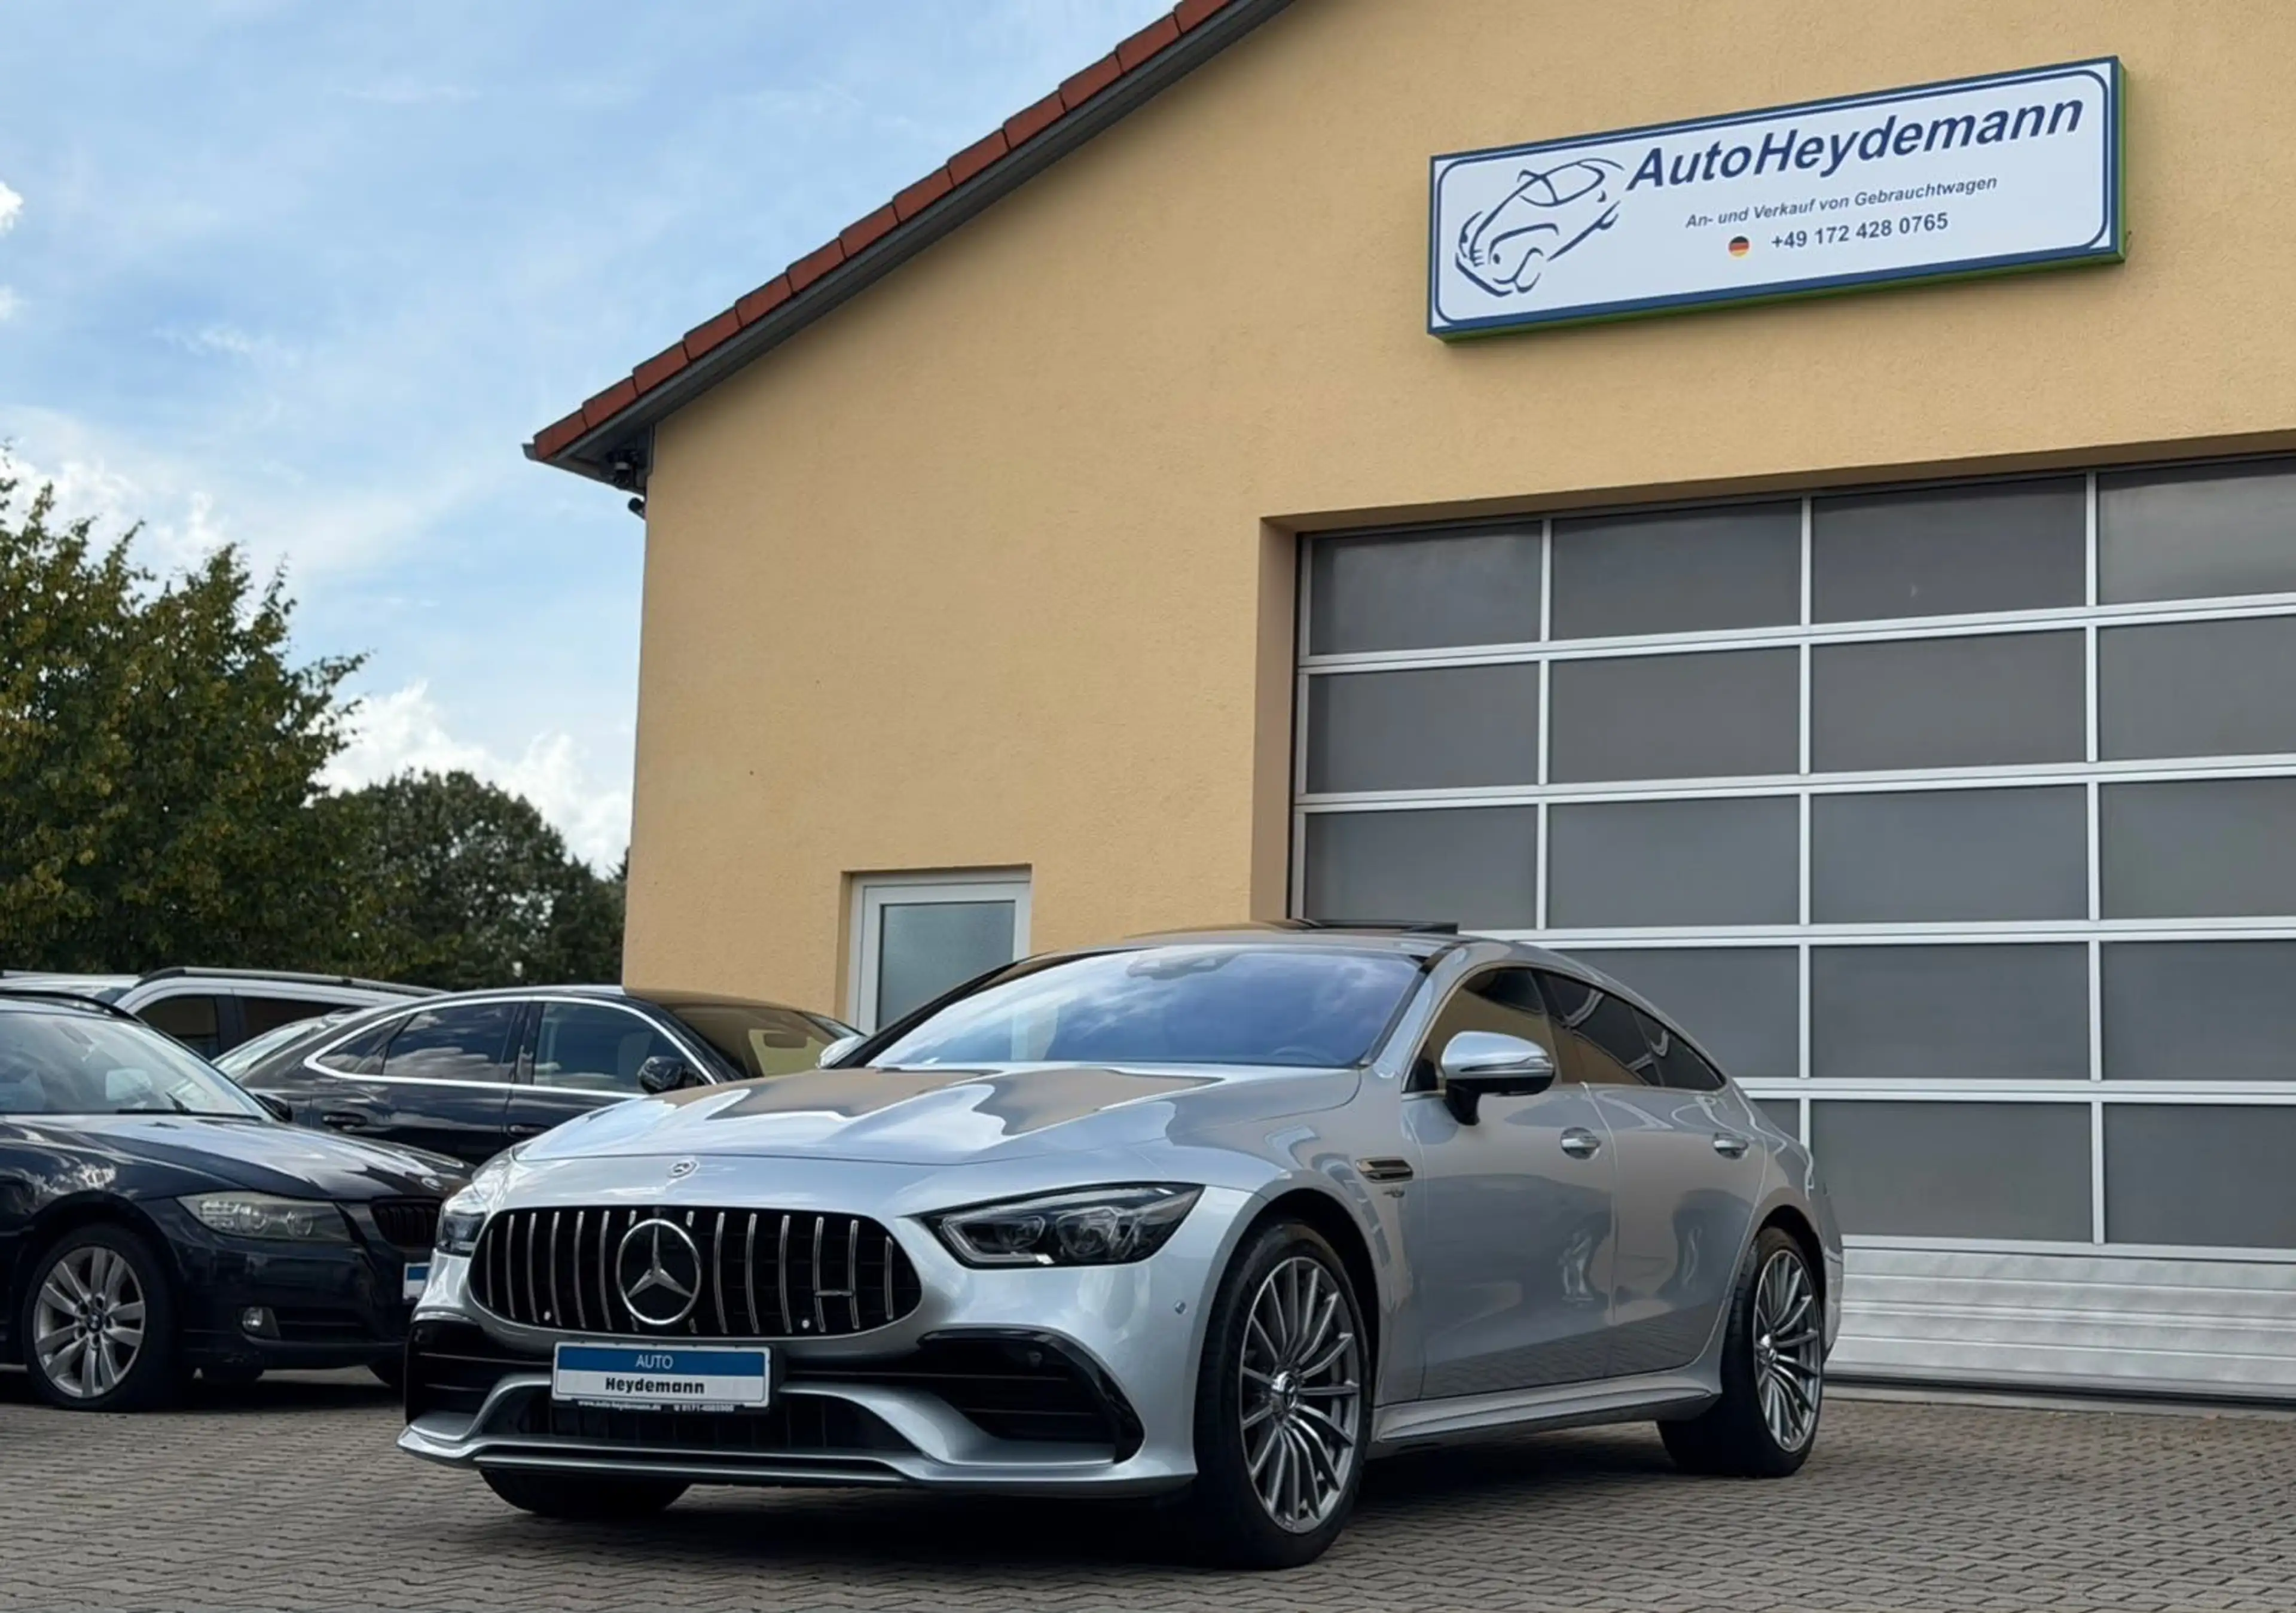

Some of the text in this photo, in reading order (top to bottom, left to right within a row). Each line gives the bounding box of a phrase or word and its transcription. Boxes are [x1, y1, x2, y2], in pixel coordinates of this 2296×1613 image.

[1626, 99, 2083, 191] AutoHeydemann
[1686, 176, 1998, 228] An- und Verkauf von Gebrauchtwagen
[1772, 212, 1949, 249] +49 172 428 0765
[635, 1354, 674, 1370] AUTO
[605, 1377, 705, 1395] Heydemann
